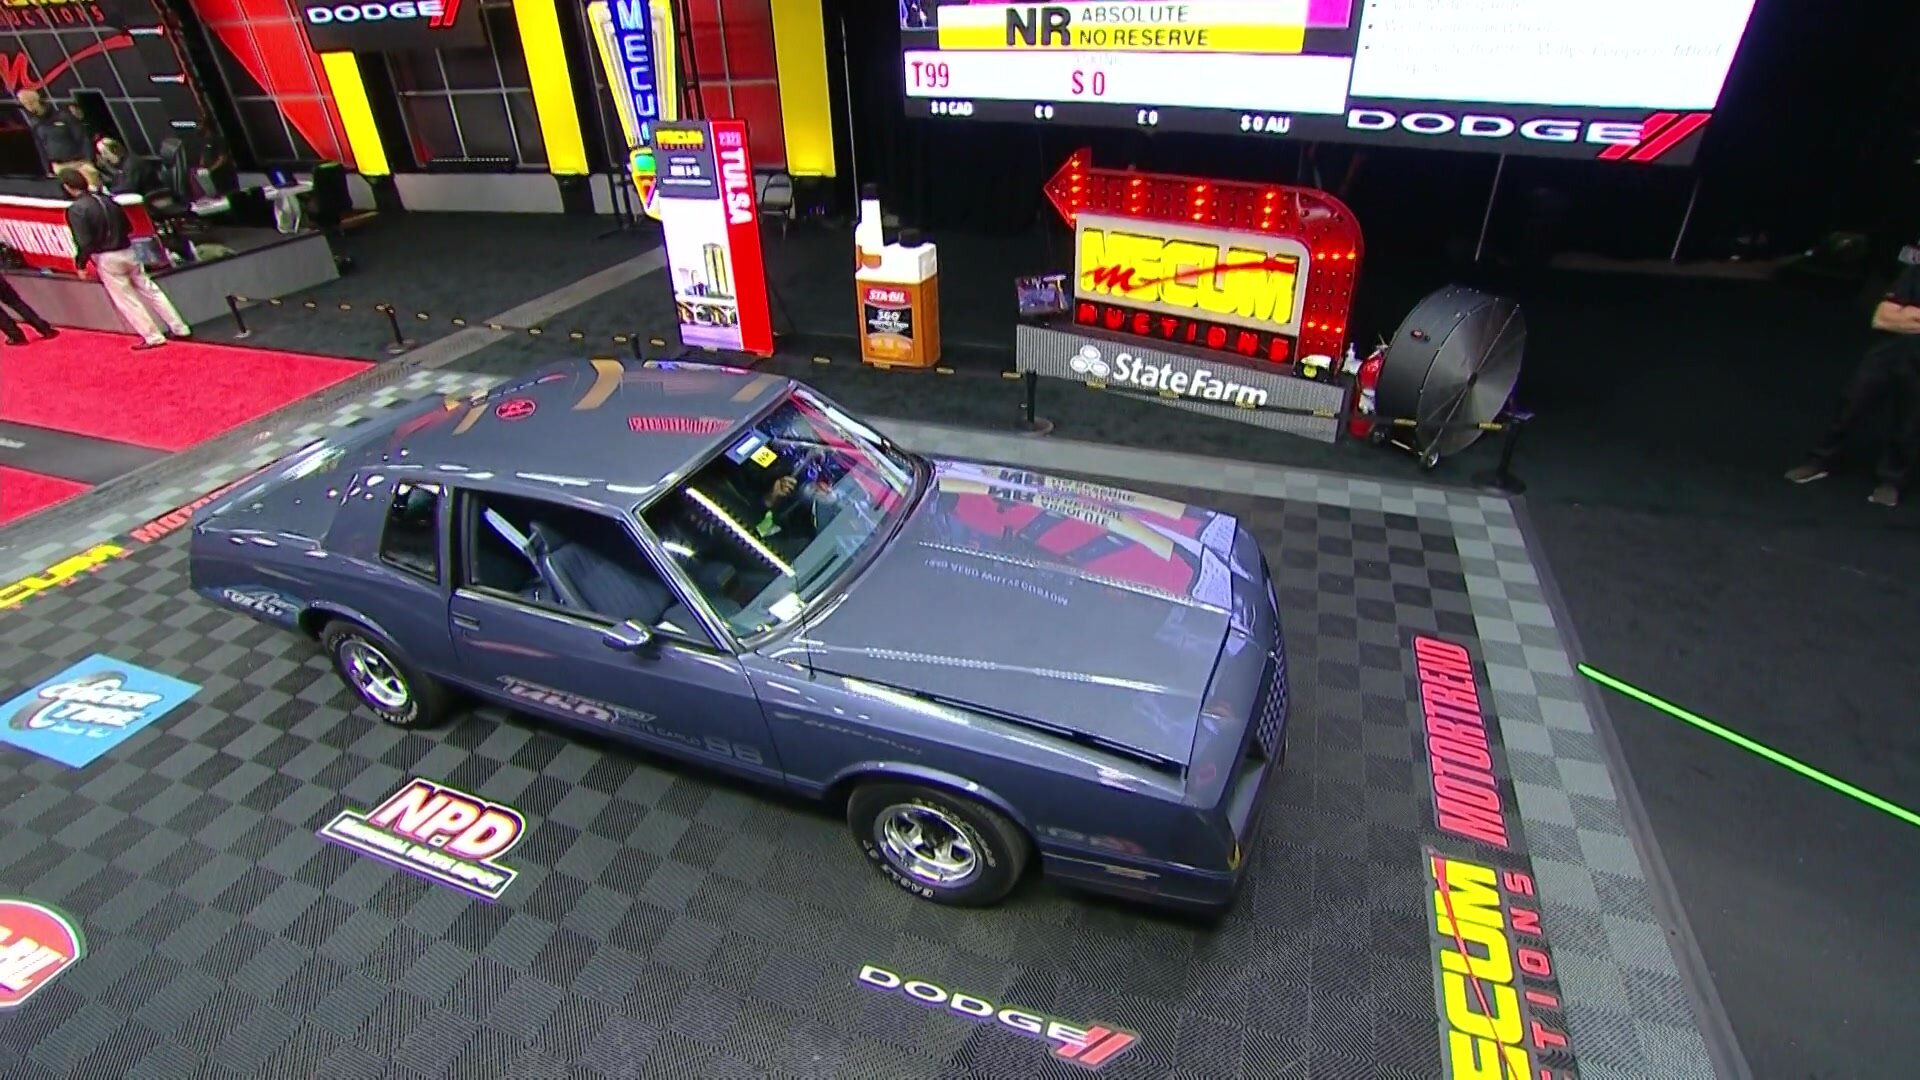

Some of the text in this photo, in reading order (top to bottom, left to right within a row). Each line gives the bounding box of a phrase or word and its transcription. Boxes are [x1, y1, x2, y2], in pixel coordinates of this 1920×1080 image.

[307, 1, 444, 23] DODGE
[1006, 7, 1072, 46] NR
[1082, 5, 1189, 23] ABSOLUTE
[1080, 29, 1209, 46] NO RESERVE
[912, 62, 949, 88] T99
[1346, 108, 1646, 145] DODGE
[720, 147, 753, 225] TULSA
[1080, 227, 1299, 325] MECUM
[1077, 303, 1290, 363] AUCTIONS
[1414, 636, 1509, 848] MOTORTREND
[368, 784, 518, 859] NPD
[857, 964, 1090, 1046] DODGE
